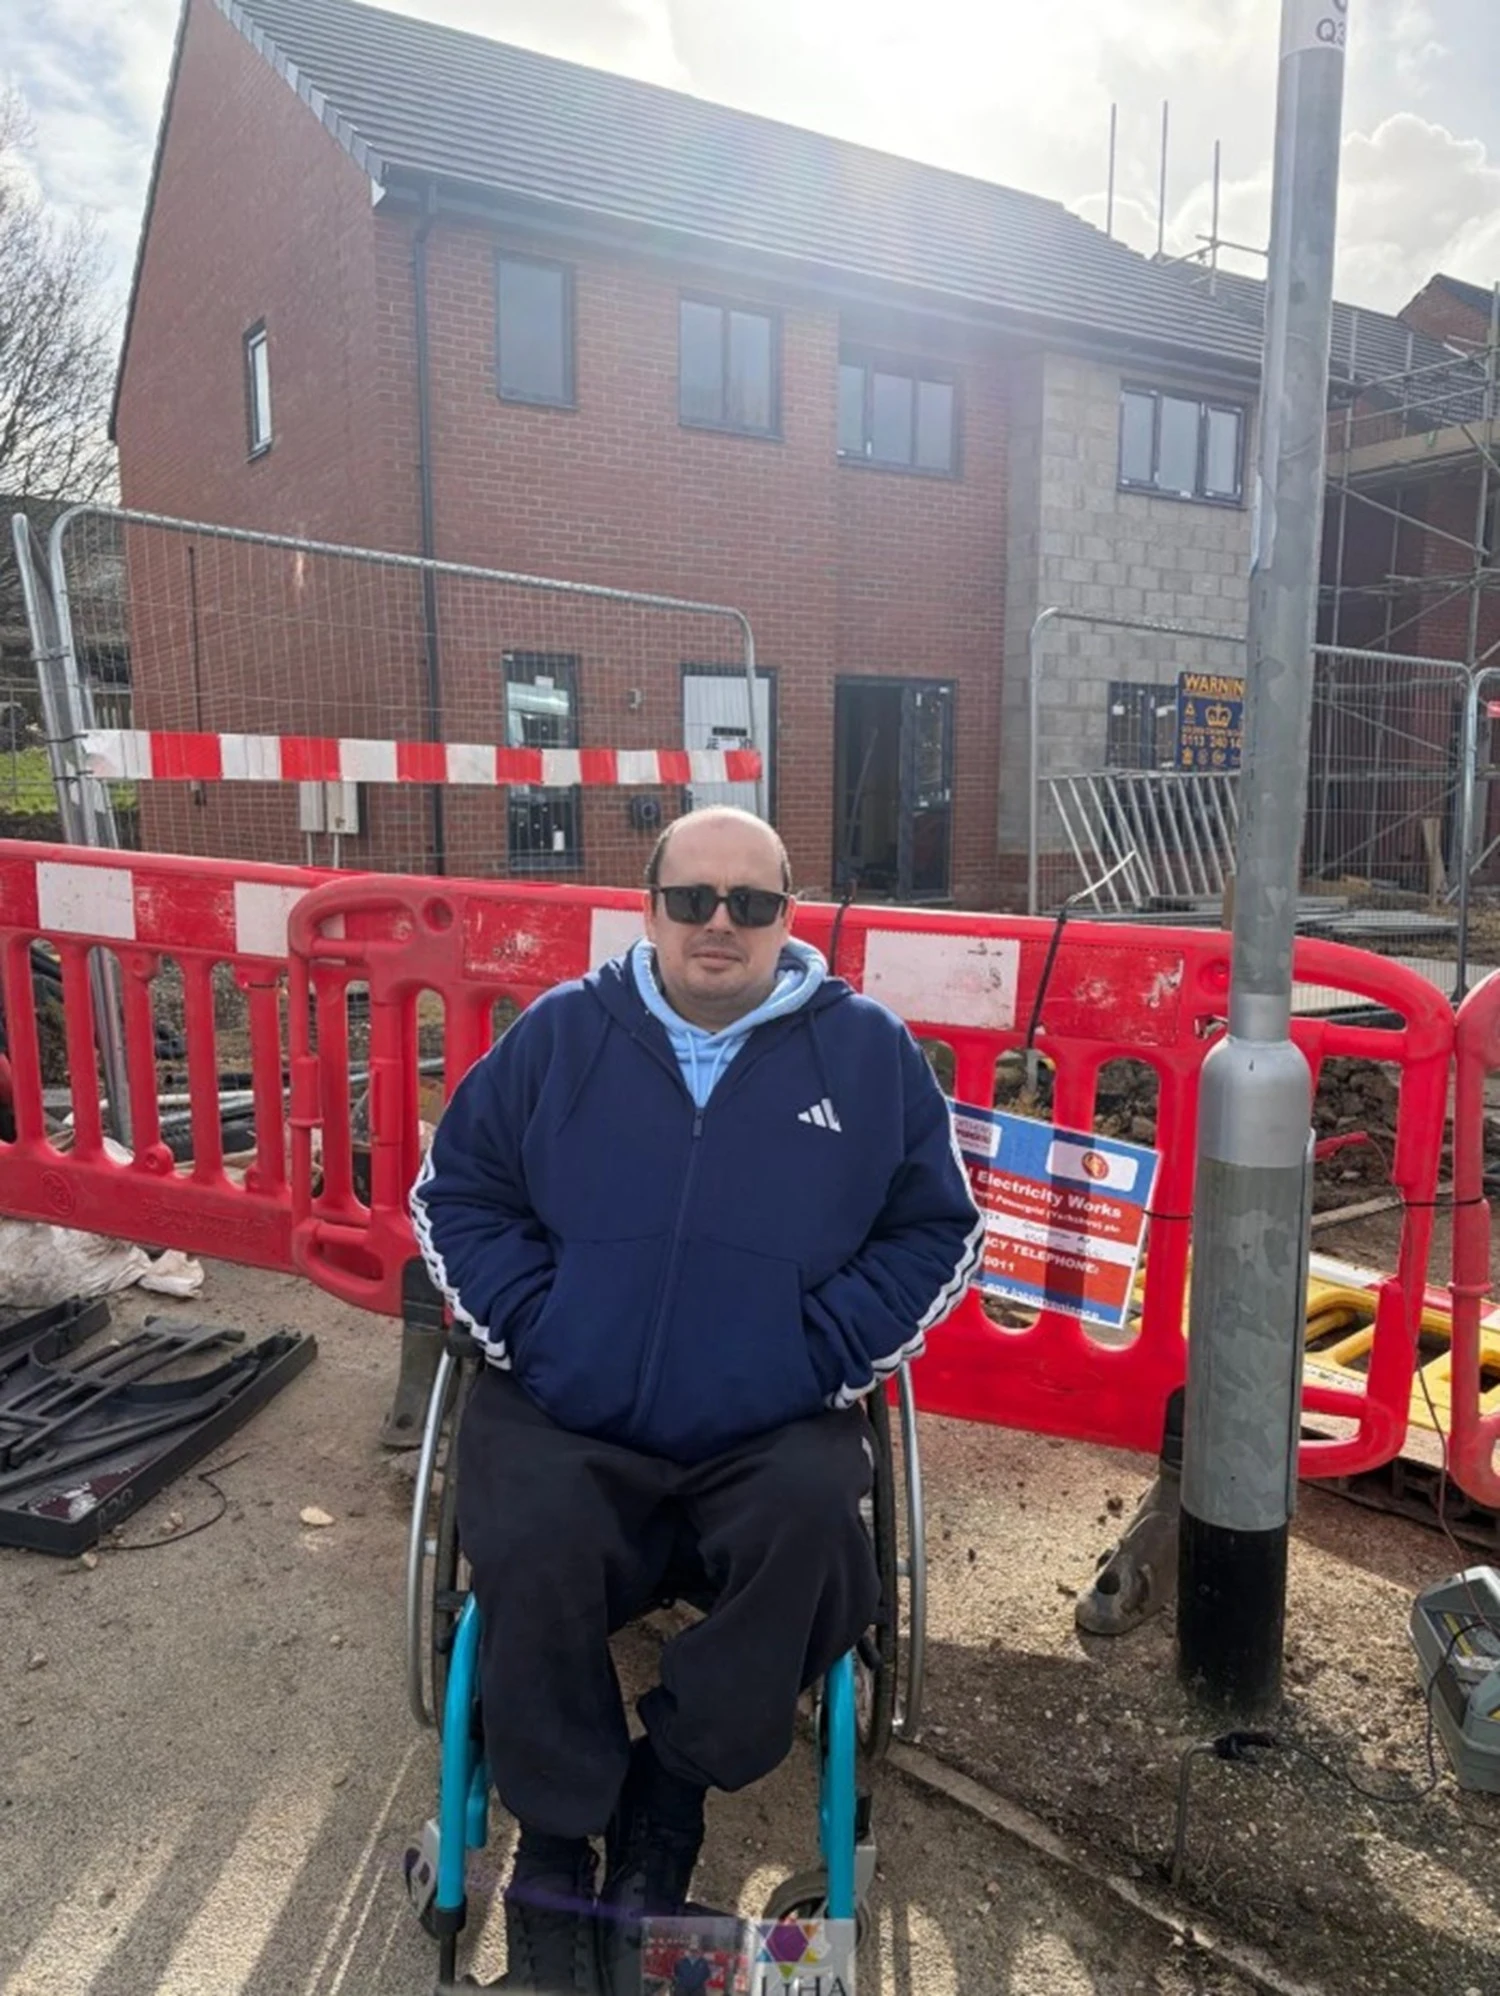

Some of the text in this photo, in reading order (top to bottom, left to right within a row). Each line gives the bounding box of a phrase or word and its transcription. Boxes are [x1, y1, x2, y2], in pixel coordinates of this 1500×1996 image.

[1184, 674, 1245, 695] WARNIN
[977, 1169, 1063, 1208] Electricity
[1068, 1193, 1122, 1219] Works
